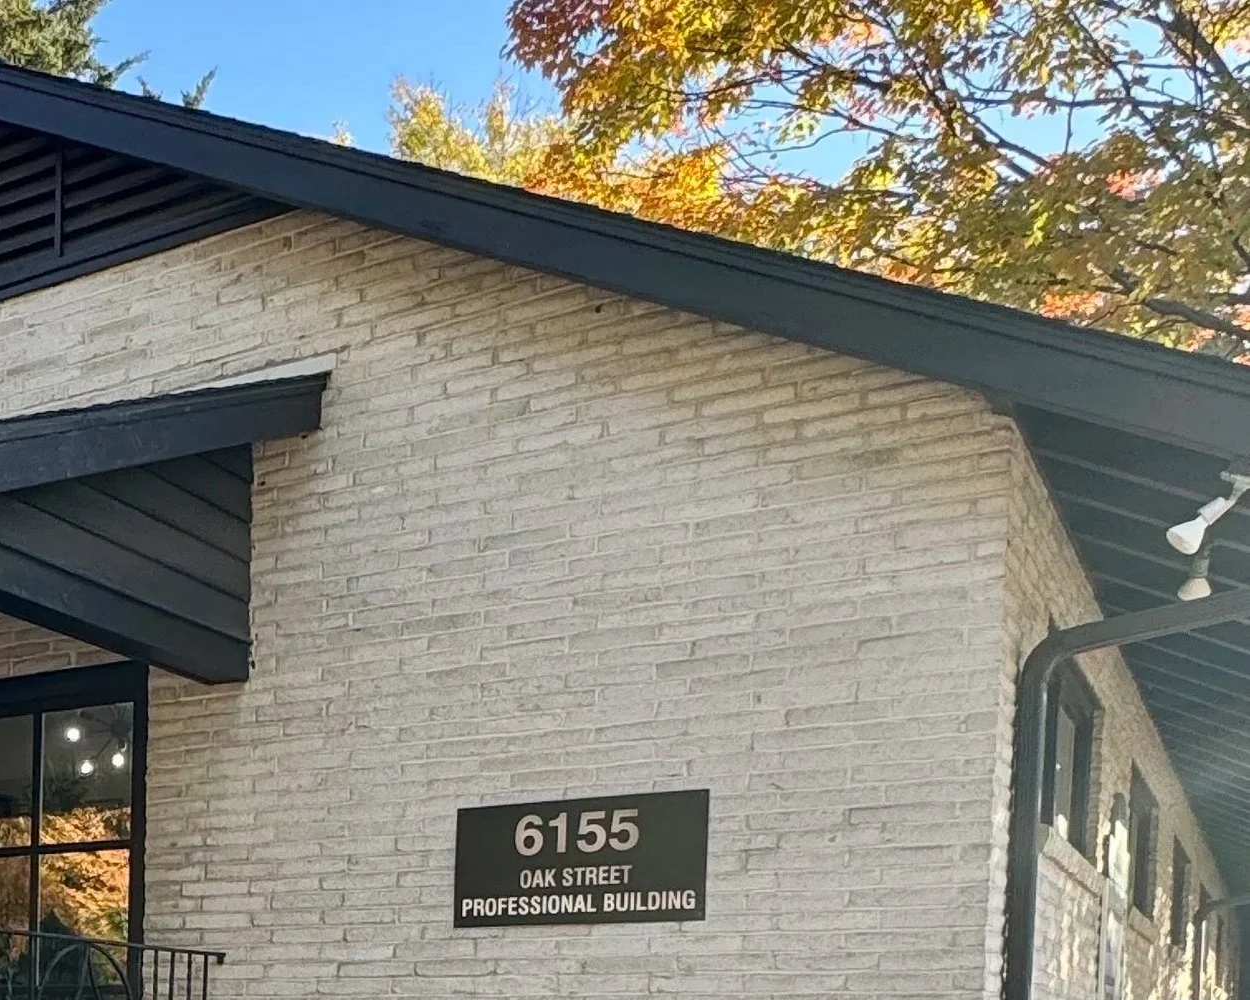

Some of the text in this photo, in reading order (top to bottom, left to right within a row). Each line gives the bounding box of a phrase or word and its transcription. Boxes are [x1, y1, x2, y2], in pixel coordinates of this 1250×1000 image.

[514, 809, 640, 857] 6155
[519, 865, 633, 889] OAK STREET
[461, 890, 697, 917] PROFESSIONAL BUILDING
